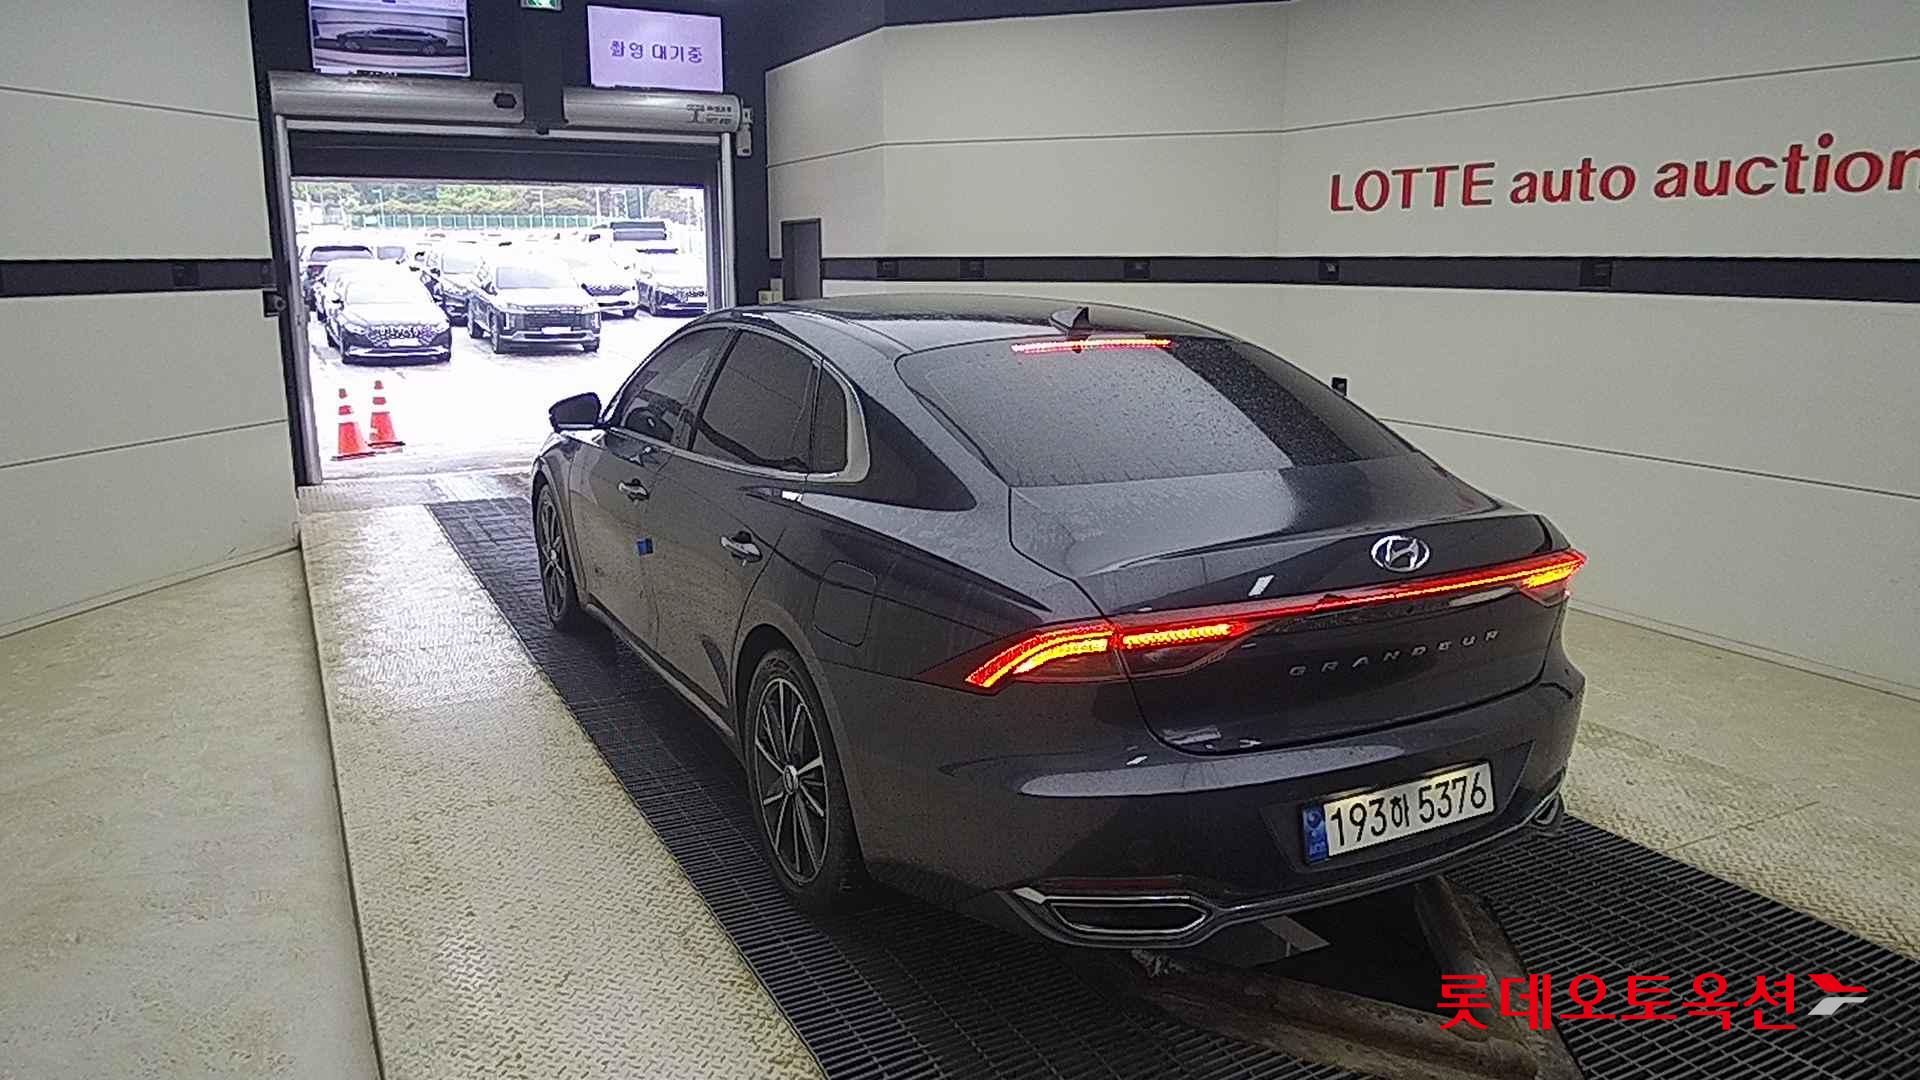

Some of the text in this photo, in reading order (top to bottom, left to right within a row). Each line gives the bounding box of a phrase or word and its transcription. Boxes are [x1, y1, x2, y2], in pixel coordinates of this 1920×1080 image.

[651, 43, 703, 64] 대기중
[1329, 161, 1496, 212] LOTTE
[1509, 157, 1637, 205] auto
[1289, 629, 1499, 676] GRANDEUR
[1418, 771, 1487, 824] 5376
